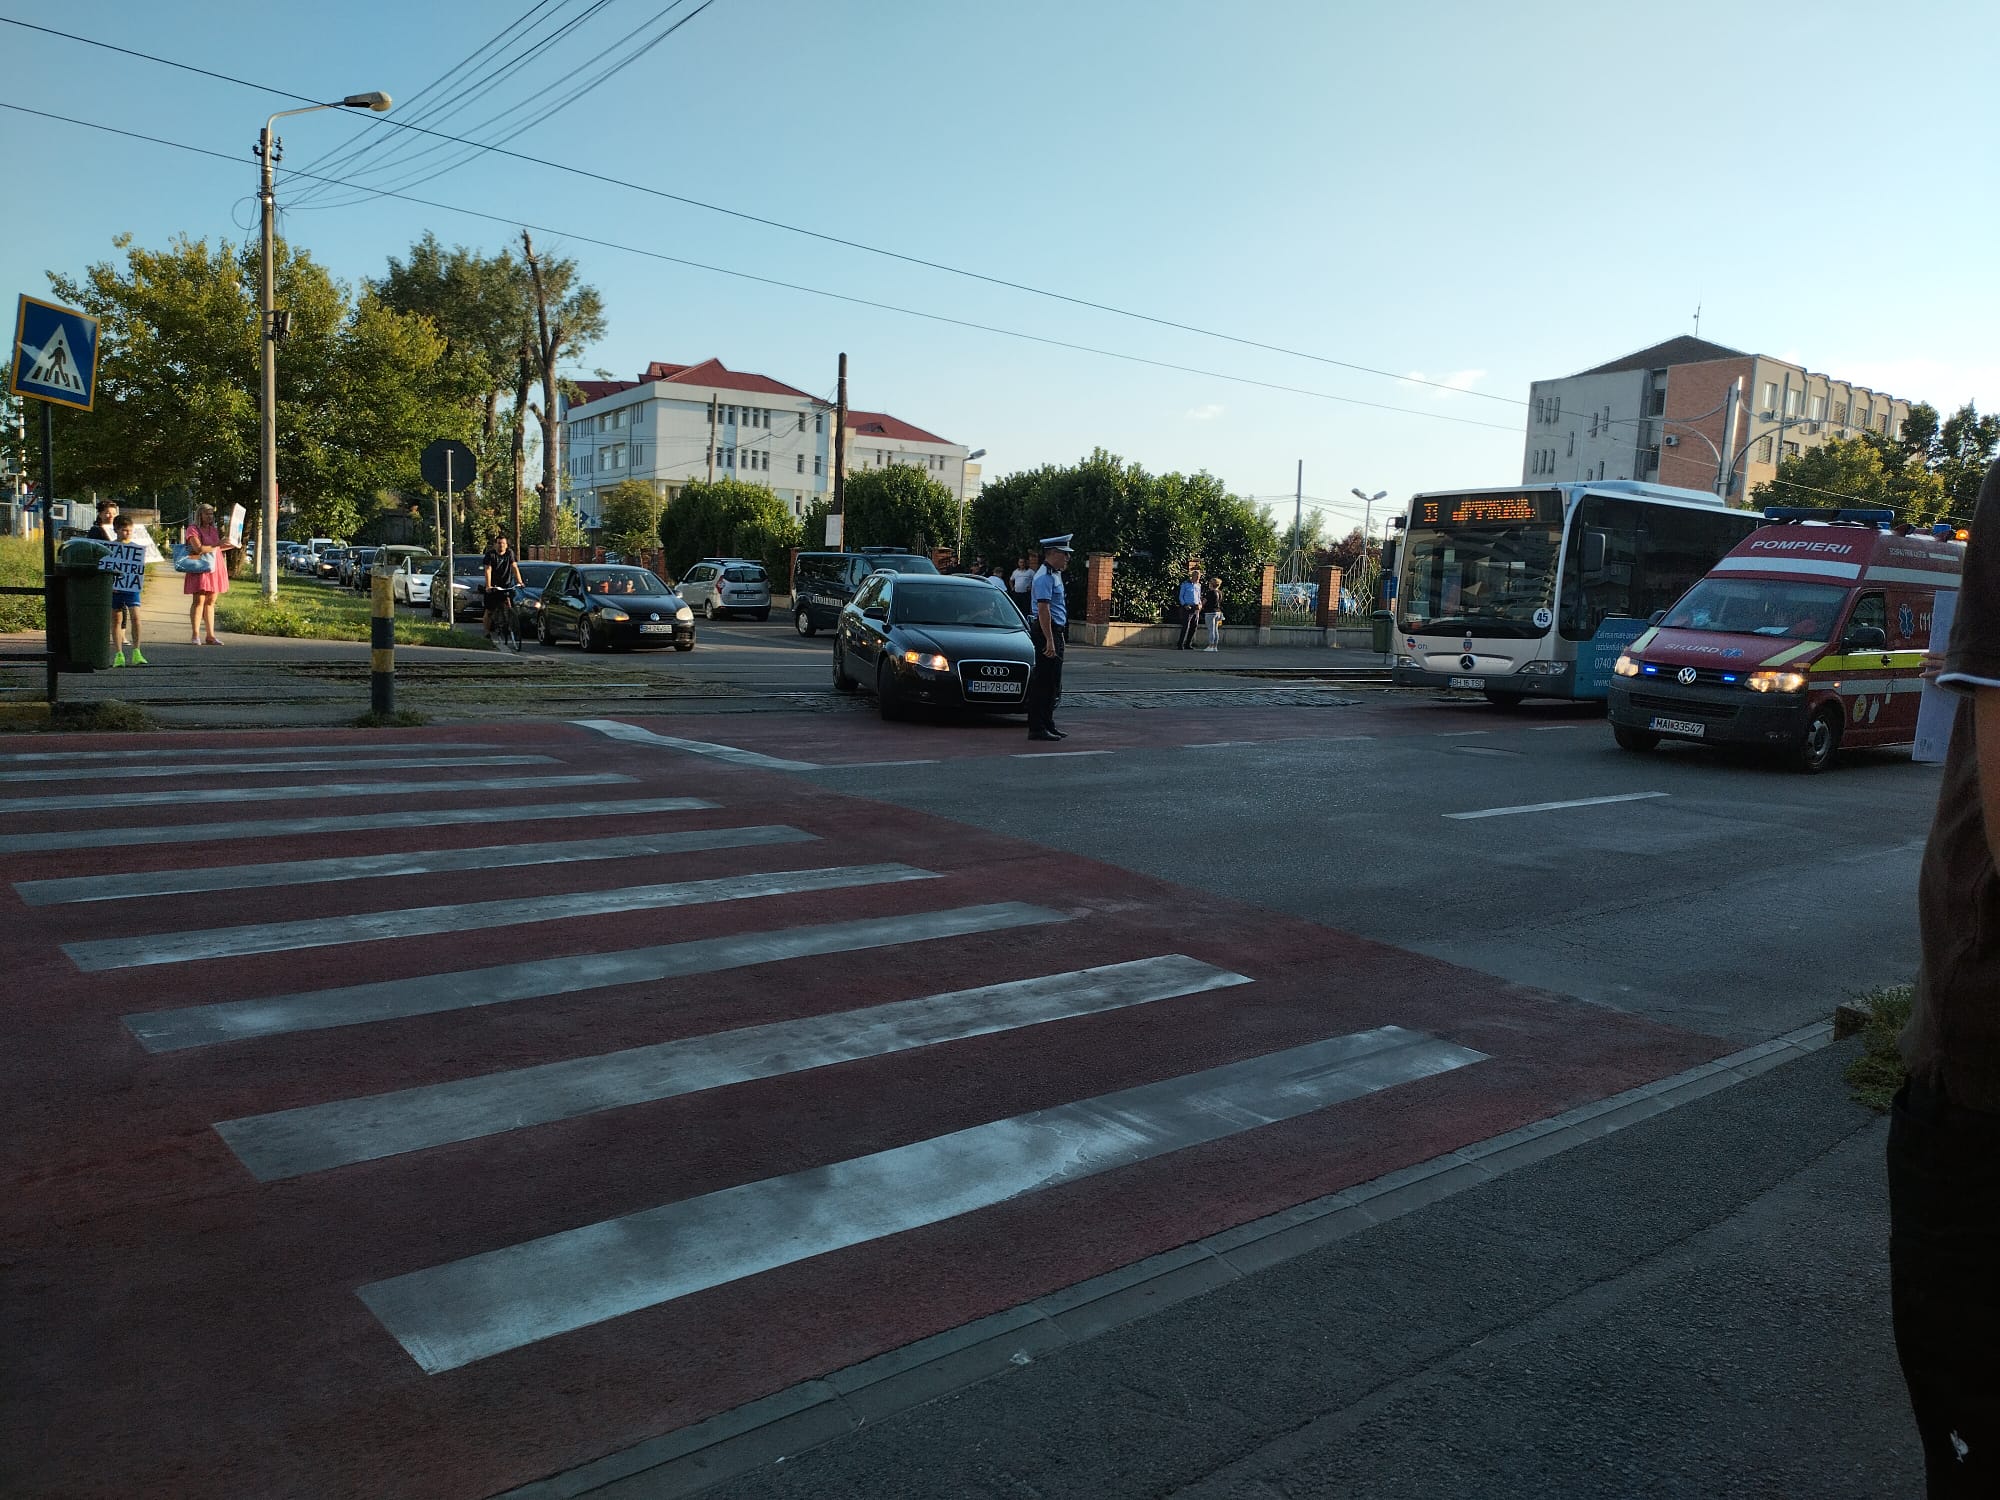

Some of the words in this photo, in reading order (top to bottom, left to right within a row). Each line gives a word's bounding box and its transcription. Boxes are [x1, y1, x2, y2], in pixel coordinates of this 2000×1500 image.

[101, 543, 143, 562] TATE
[1751, 540, 1852, 554] POMPIERII
[112, 573, 142, 590] RIA
[1537, 612, 1548, 623] 45
[973, 681, 987, 691] BH
[990, 682, 1000, 692] 78
